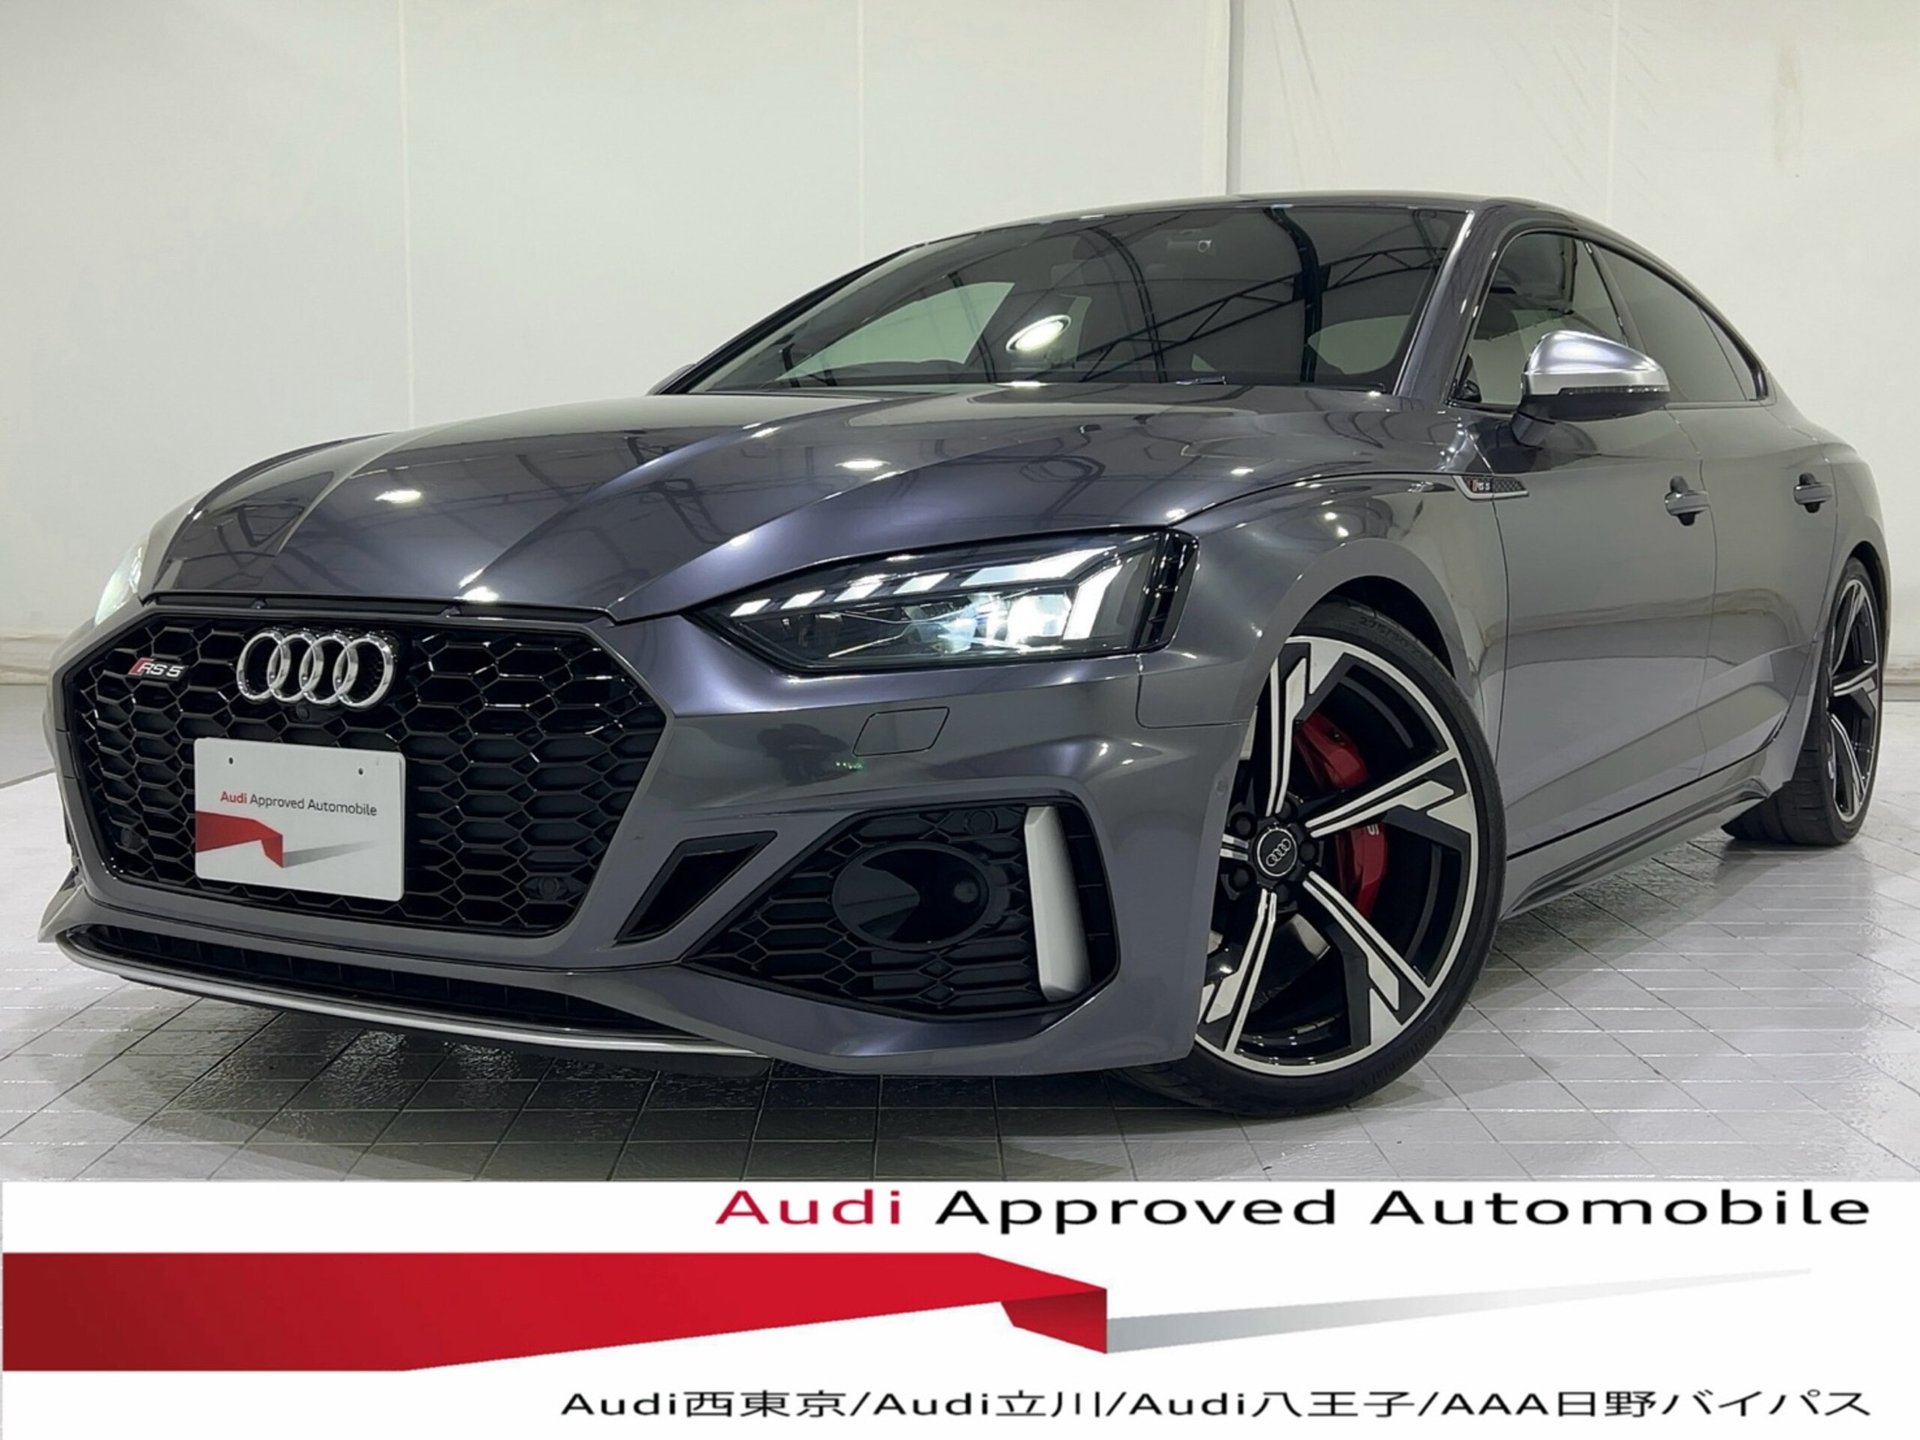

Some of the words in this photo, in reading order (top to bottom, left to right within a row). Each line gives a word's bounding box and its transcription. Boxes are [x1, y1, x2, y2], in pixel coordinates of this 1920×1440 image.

[220, 791, 248, 804] Audi
[250, 793, 305, 809] Approved
[307, 799, 378, 816] Automobile
